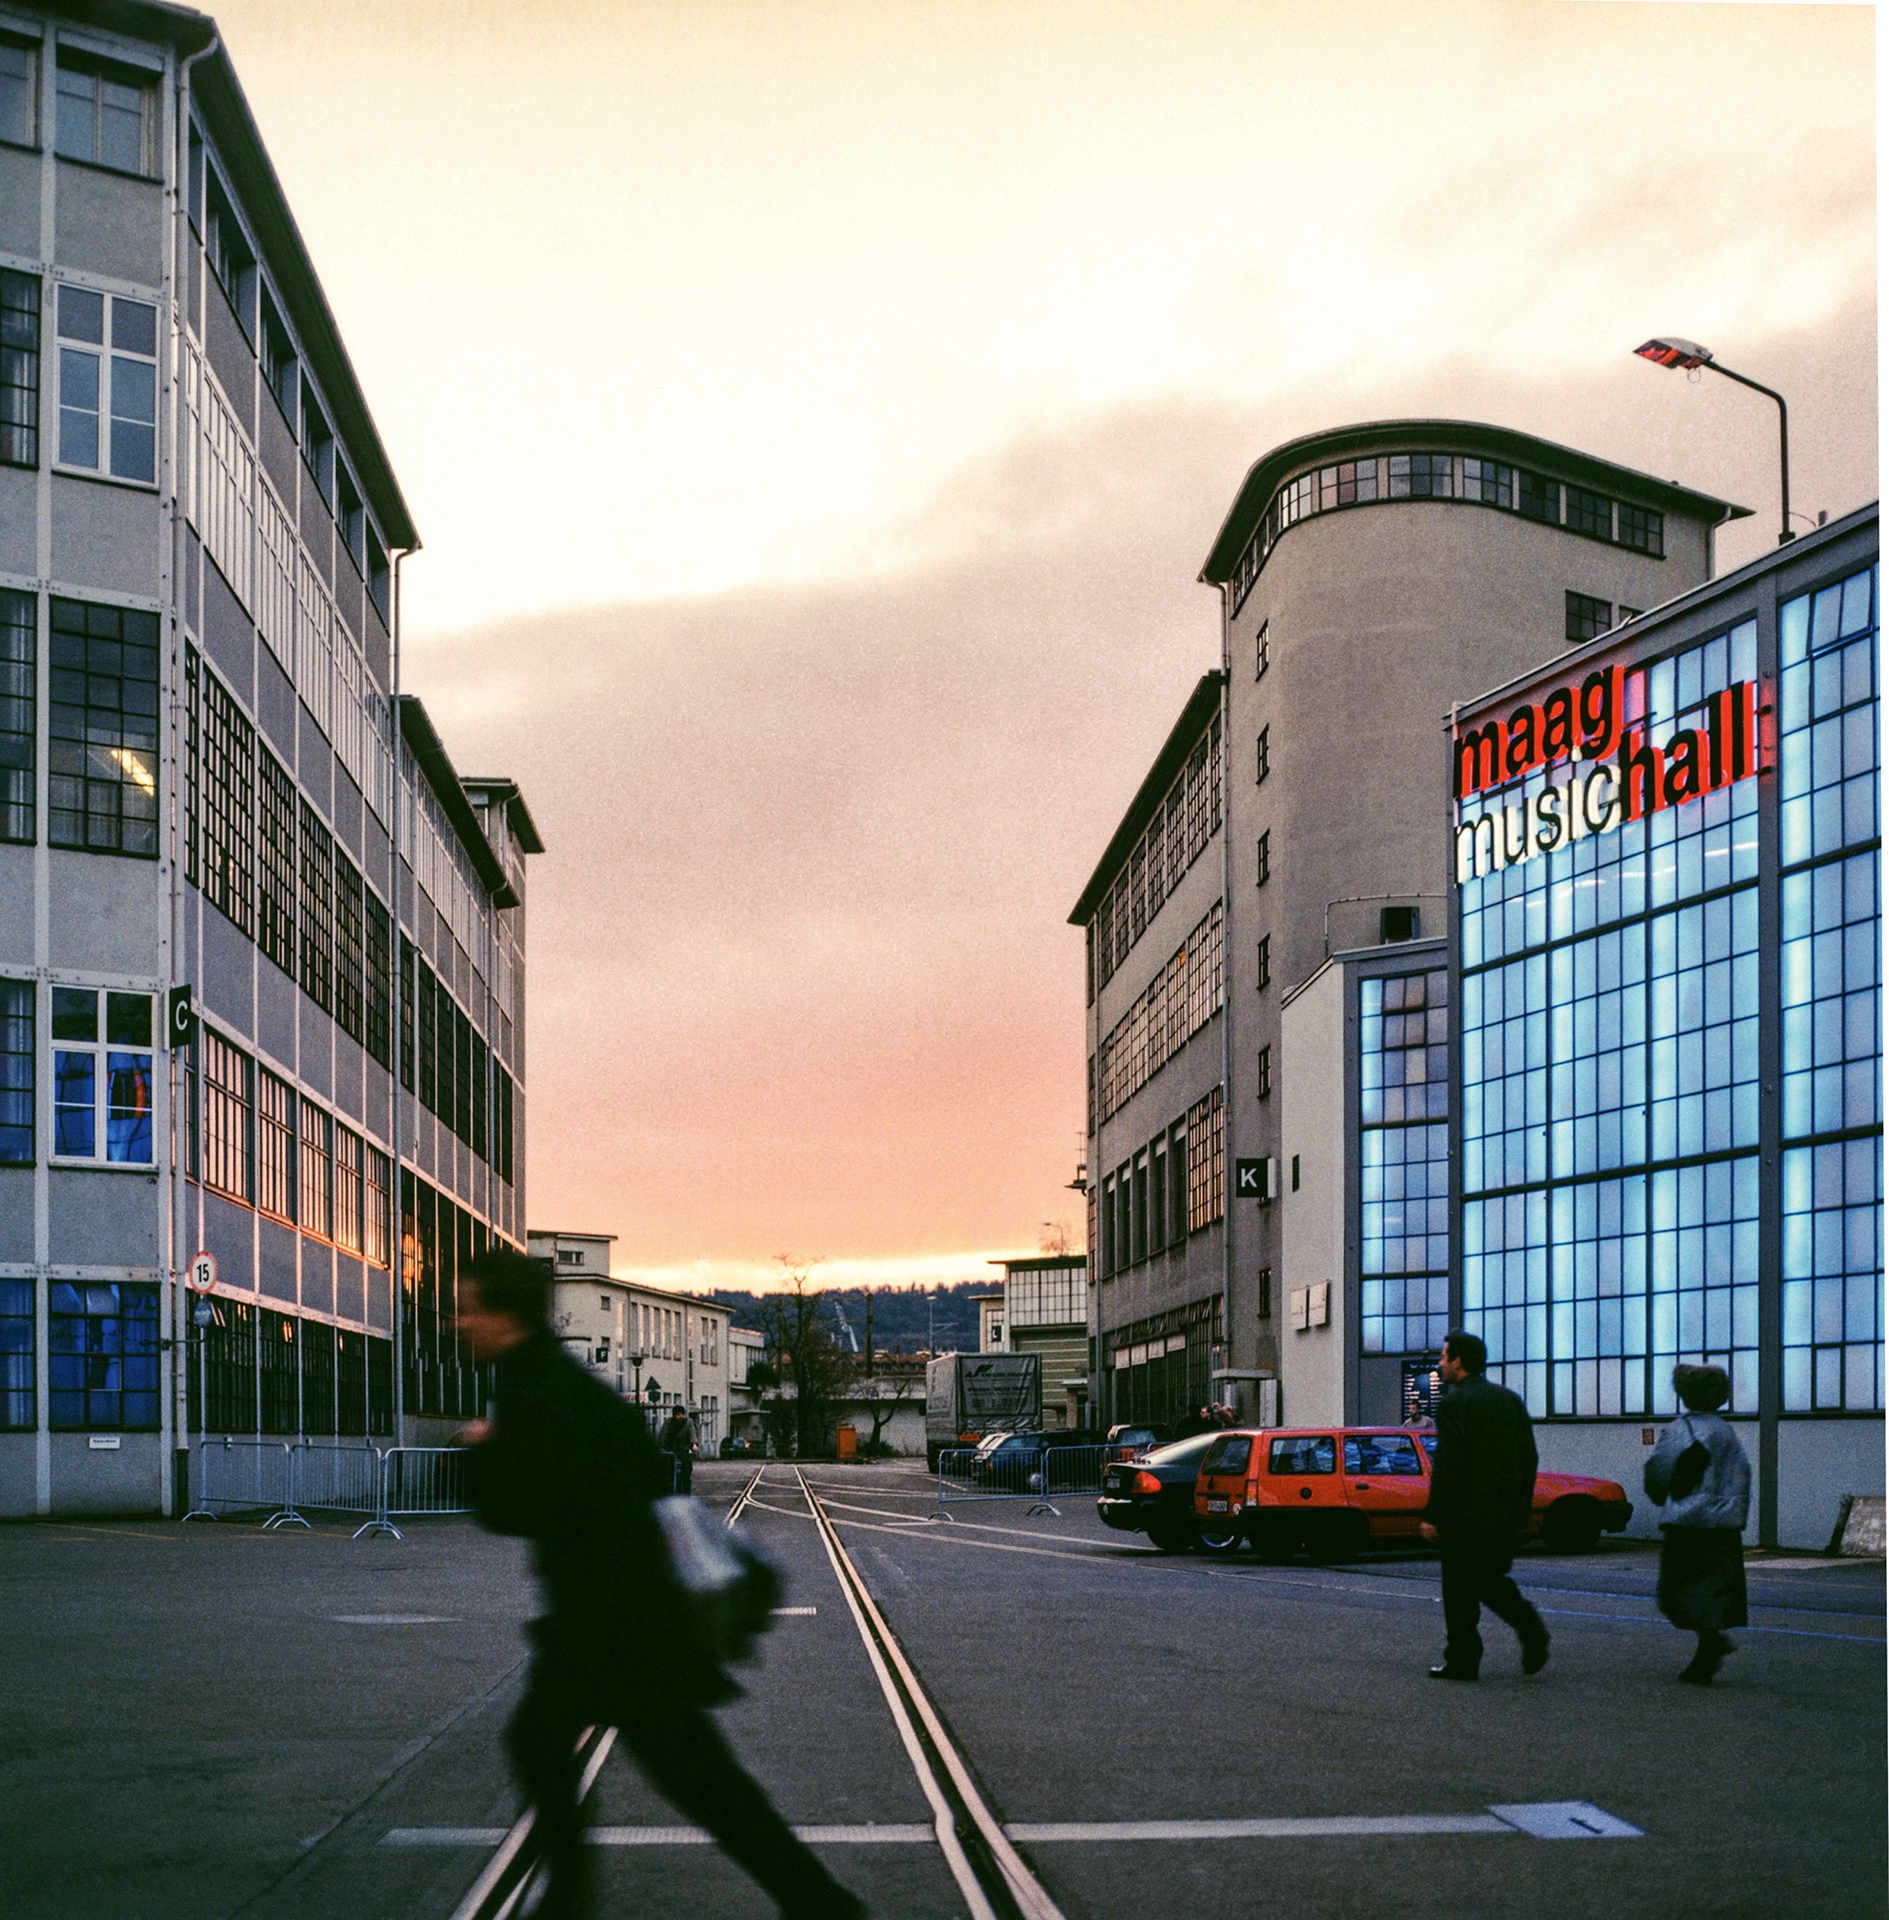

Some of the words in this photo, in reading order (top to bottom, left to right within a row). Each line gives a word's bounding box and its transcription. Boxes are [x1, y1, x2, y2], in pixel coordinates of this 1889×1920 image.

[1453, 664, 1625, 801] maag
[1453, 745, 1621, 887] music
[1618, 680, 1755, 823] hall
[175, 1000, 188, 1031] C
[1240, 1167, 1258, 1188] K
[196, 1263, 210, 1283] 15
